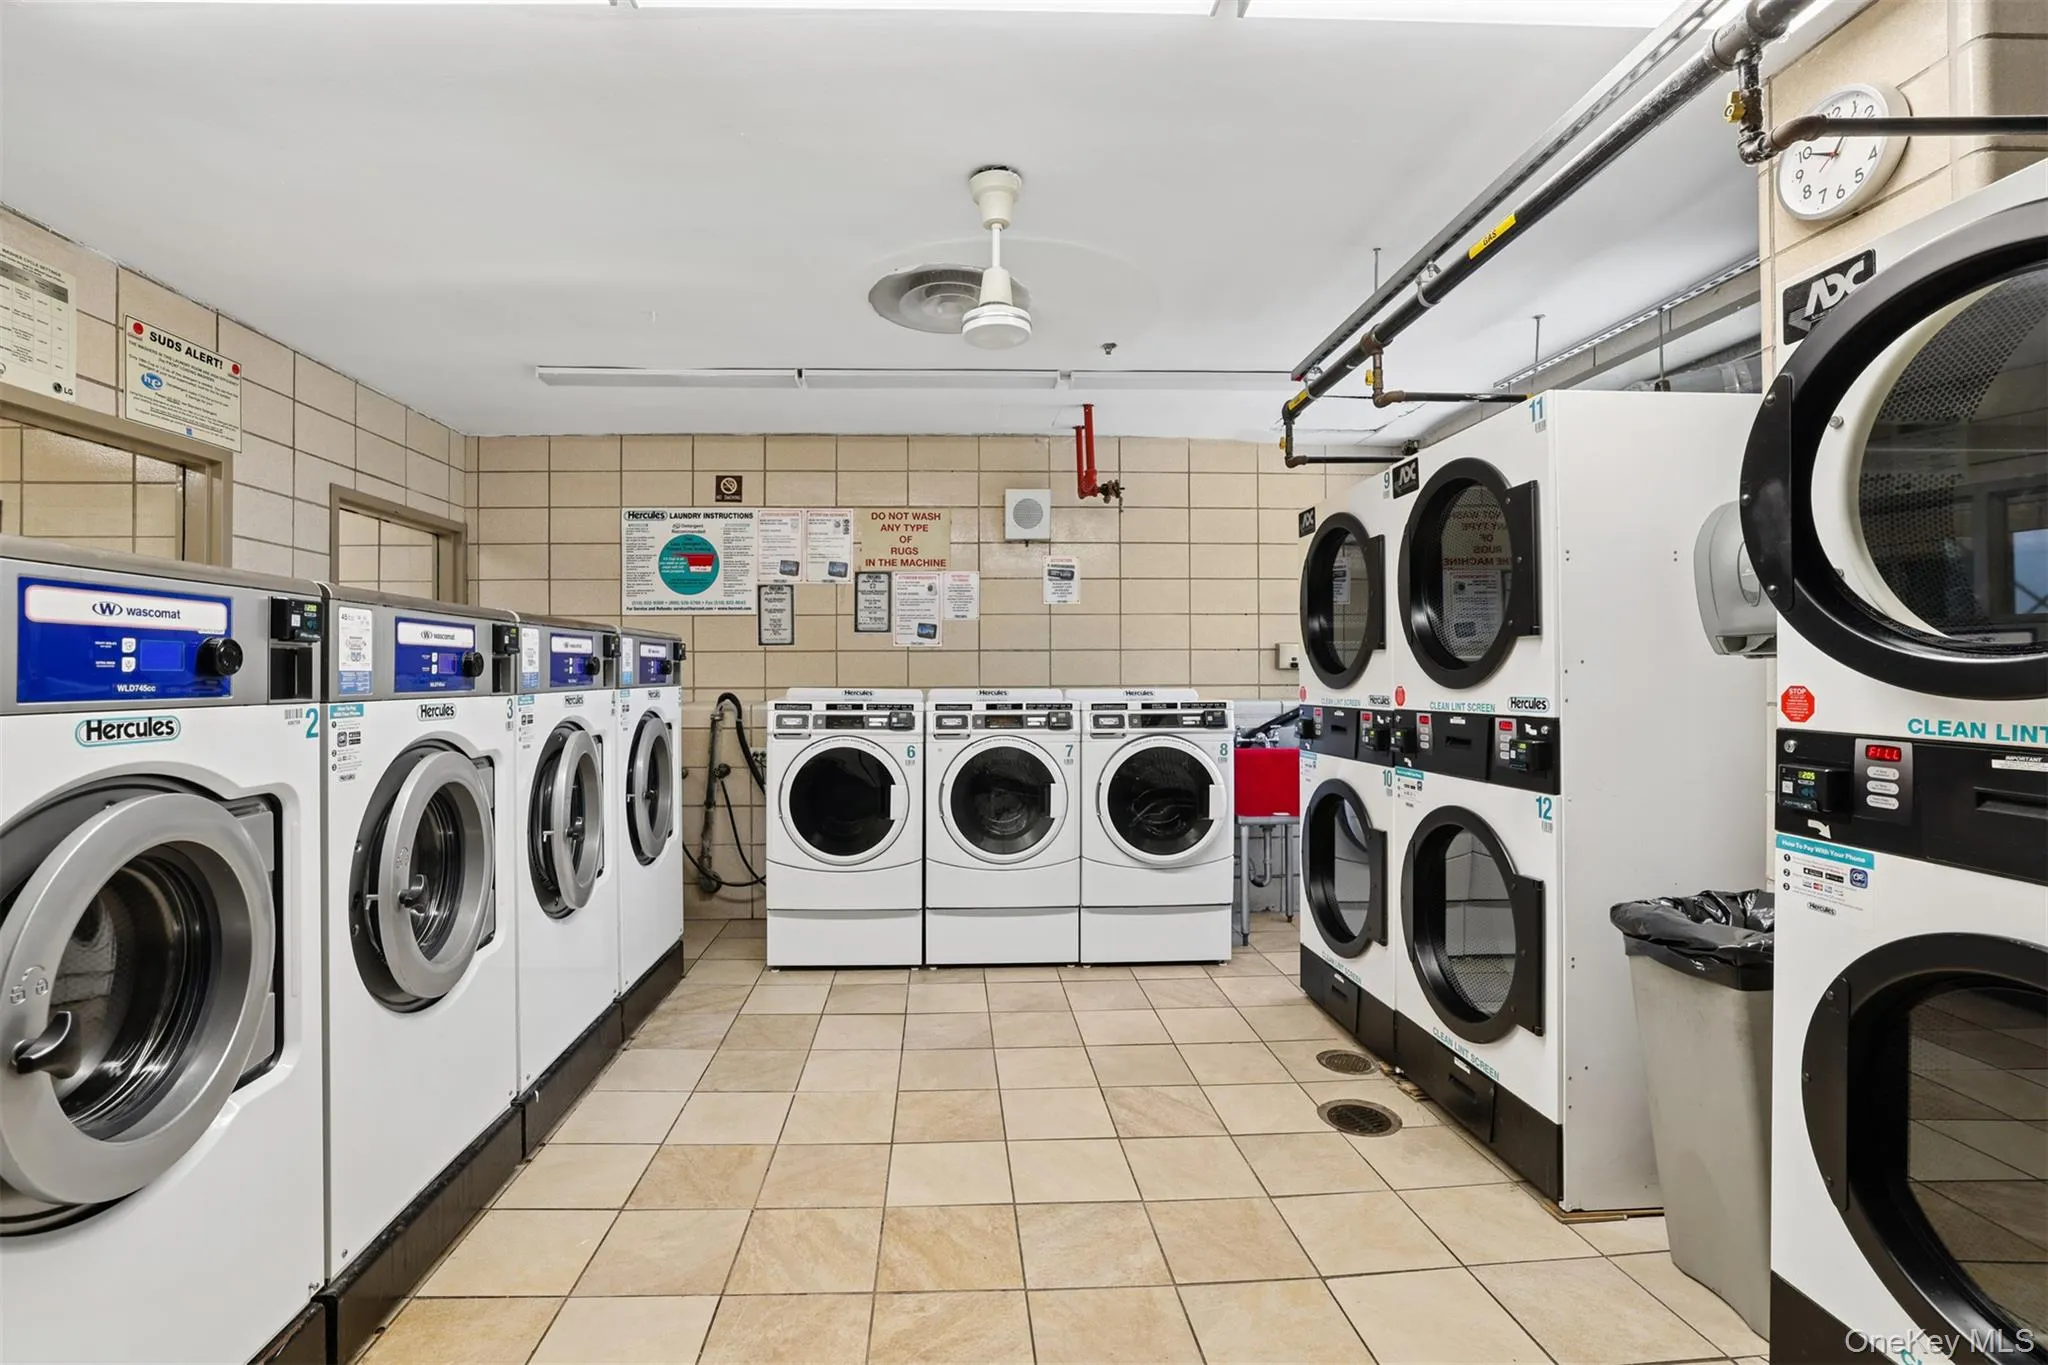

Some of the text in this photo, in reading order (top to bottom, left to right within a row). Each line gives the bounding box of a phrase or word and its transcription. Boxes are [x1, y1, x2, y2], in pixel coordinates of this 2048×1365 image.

[1797, 146, 1812, 163] 10
[1867, 144, 1877, 161] 4
[1795, 169, 1804, 183] 9
[1854, 167, 1864, 184] 5
[1803, 184, 1812, 200] 8
[1819, 187, 1828, 204] 7
[1836, 183, 1845, 199] 6
[1483, 229, 1497, 246] GAS
[1804, 259, 1865, 317] ADC
[149, 331, 223, 370] SUDS ALERT!
[64, 387, 73, 395] LG
[1529, 396, 1543, 422] 11
[1384, 472, 1390, 488] 9
[627, 511, 754, 520] Hercules LAUNDRY INSTRUCTIONS
[871, 512, 941, 520] DO NOT WASH
[880, 524, 928, 532] ANY TYPE
[899, 535, 912, 543] OF
[890, 547, 919, 555] RUGS
[865, 559, 946, 567] IN THE MACHINE
[126, 607, 181, 620] wascomat
[420, 704, 455, 718] Hercules
[506, 698, 514, 719] 3
[1429, 701, 1496, 712] CLEAN LINT SCREEN
[1510, 697, 1547, 710] Hercules
[85, 717, 175, 741] Hercules
[305, 707, 319, 739] 2
[1907, 718, 1986, 739] CLEAN
[907, 745, 916, 758] 6
[1065, 744, 1074, 758] 7
[1220, 743, 1228, 756] 8
[1867, 746, 1900, 760] FILL
[2005, 755, 2043, 763] IMPORTANT
[1383, 769, 1392, 787] 10
[1535, 796, 1553, 820] 12
[1782, 839, 1795, 848] How
[1803, 844, 1814, 853] Pay
[1815, 846, 1830, 856] With
[1830, 849, 1845, 859] Your
[1845, 853, 1866, 863] Phone
[1432, 1027, 1500, 1081] CLEAN LINT SCREEN
